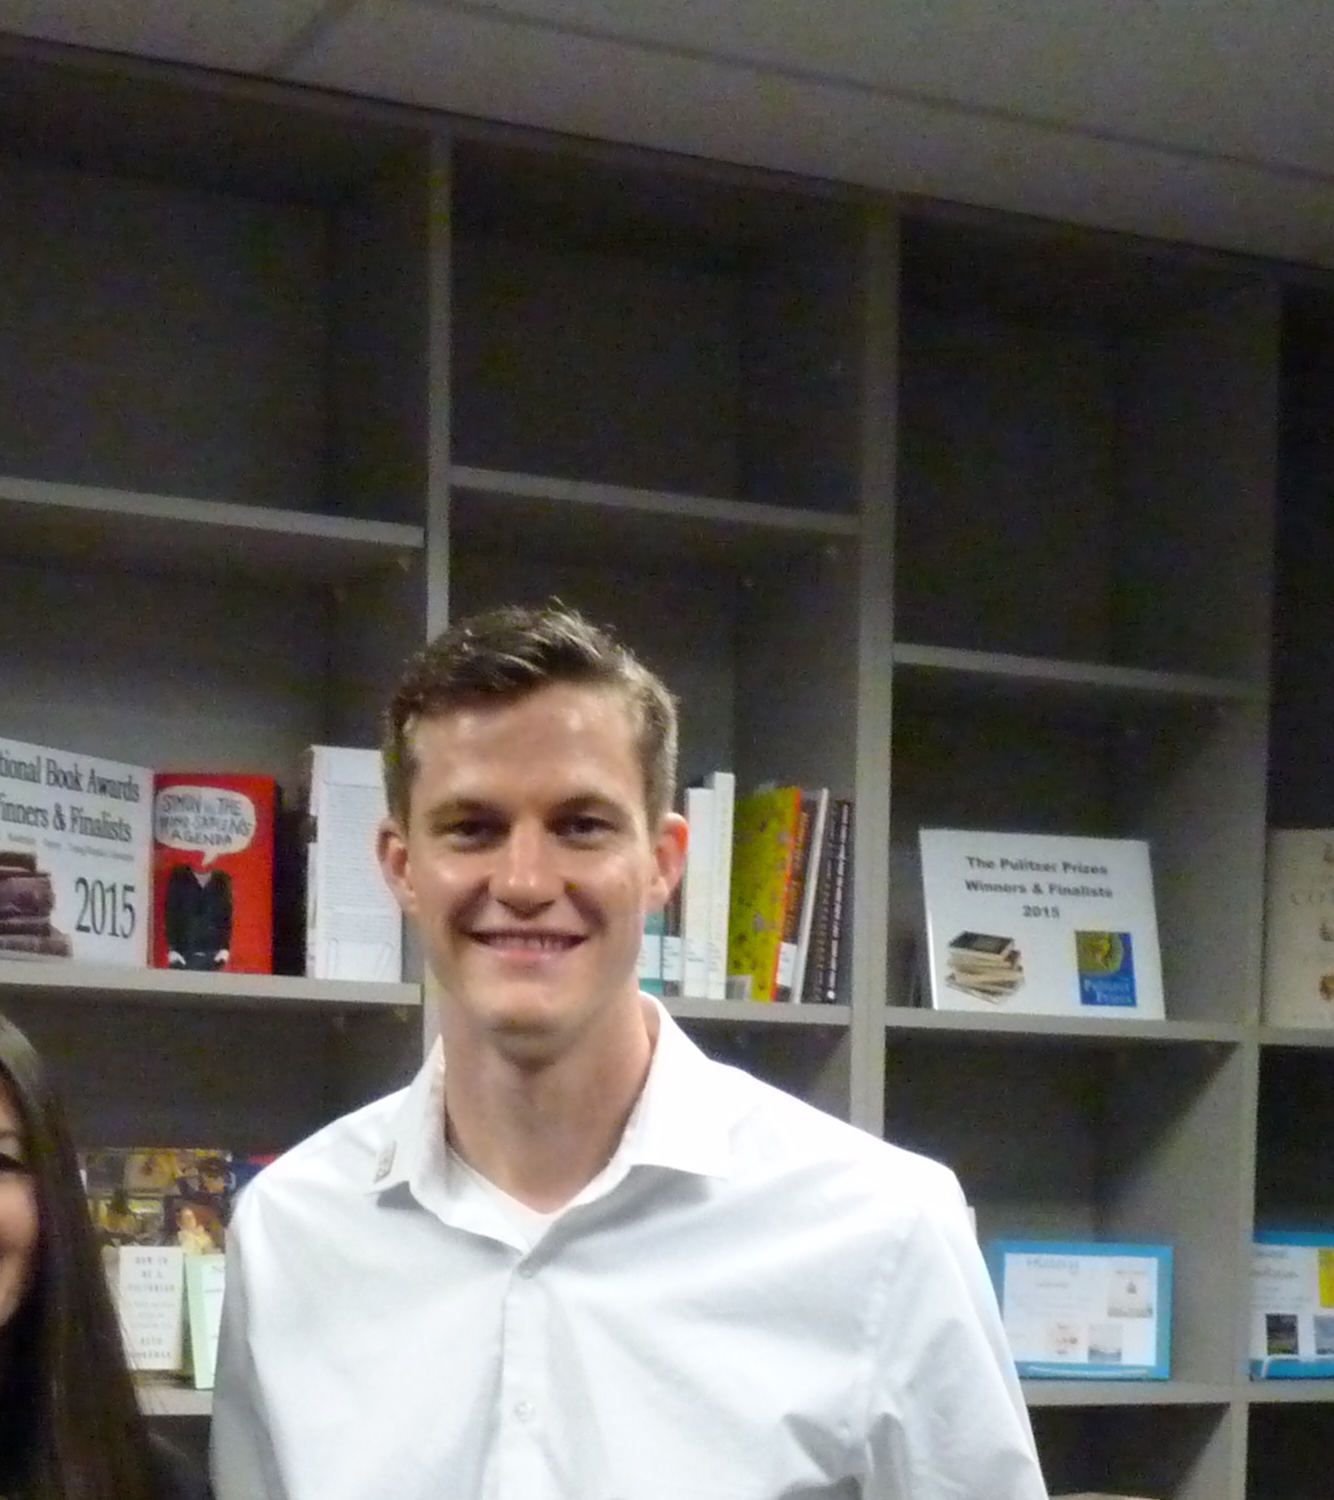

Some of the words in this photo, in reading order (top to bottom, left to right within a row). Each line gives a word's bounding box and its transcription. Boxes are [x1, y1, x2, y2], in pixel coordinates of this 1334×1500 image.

[45, 757, 83, 792] Book
[86, 767, 141, 803] Awards
[52, 802, 66, 832] &
[69, 804, 133, 843] Finalists
[964, 856, 995, 870] The
[1000, 858, 1057, 873] Pulitzer
[1062, 861, 1108, 875] Prizes
[964, 880, 1027, 895] Winners
[1032, 883, 1044, 895] &
[1048, 883, 1114, 898] Finalists
[74, 876, 136, 939] 2015
[1022, 905, 1060, 919] 2015
